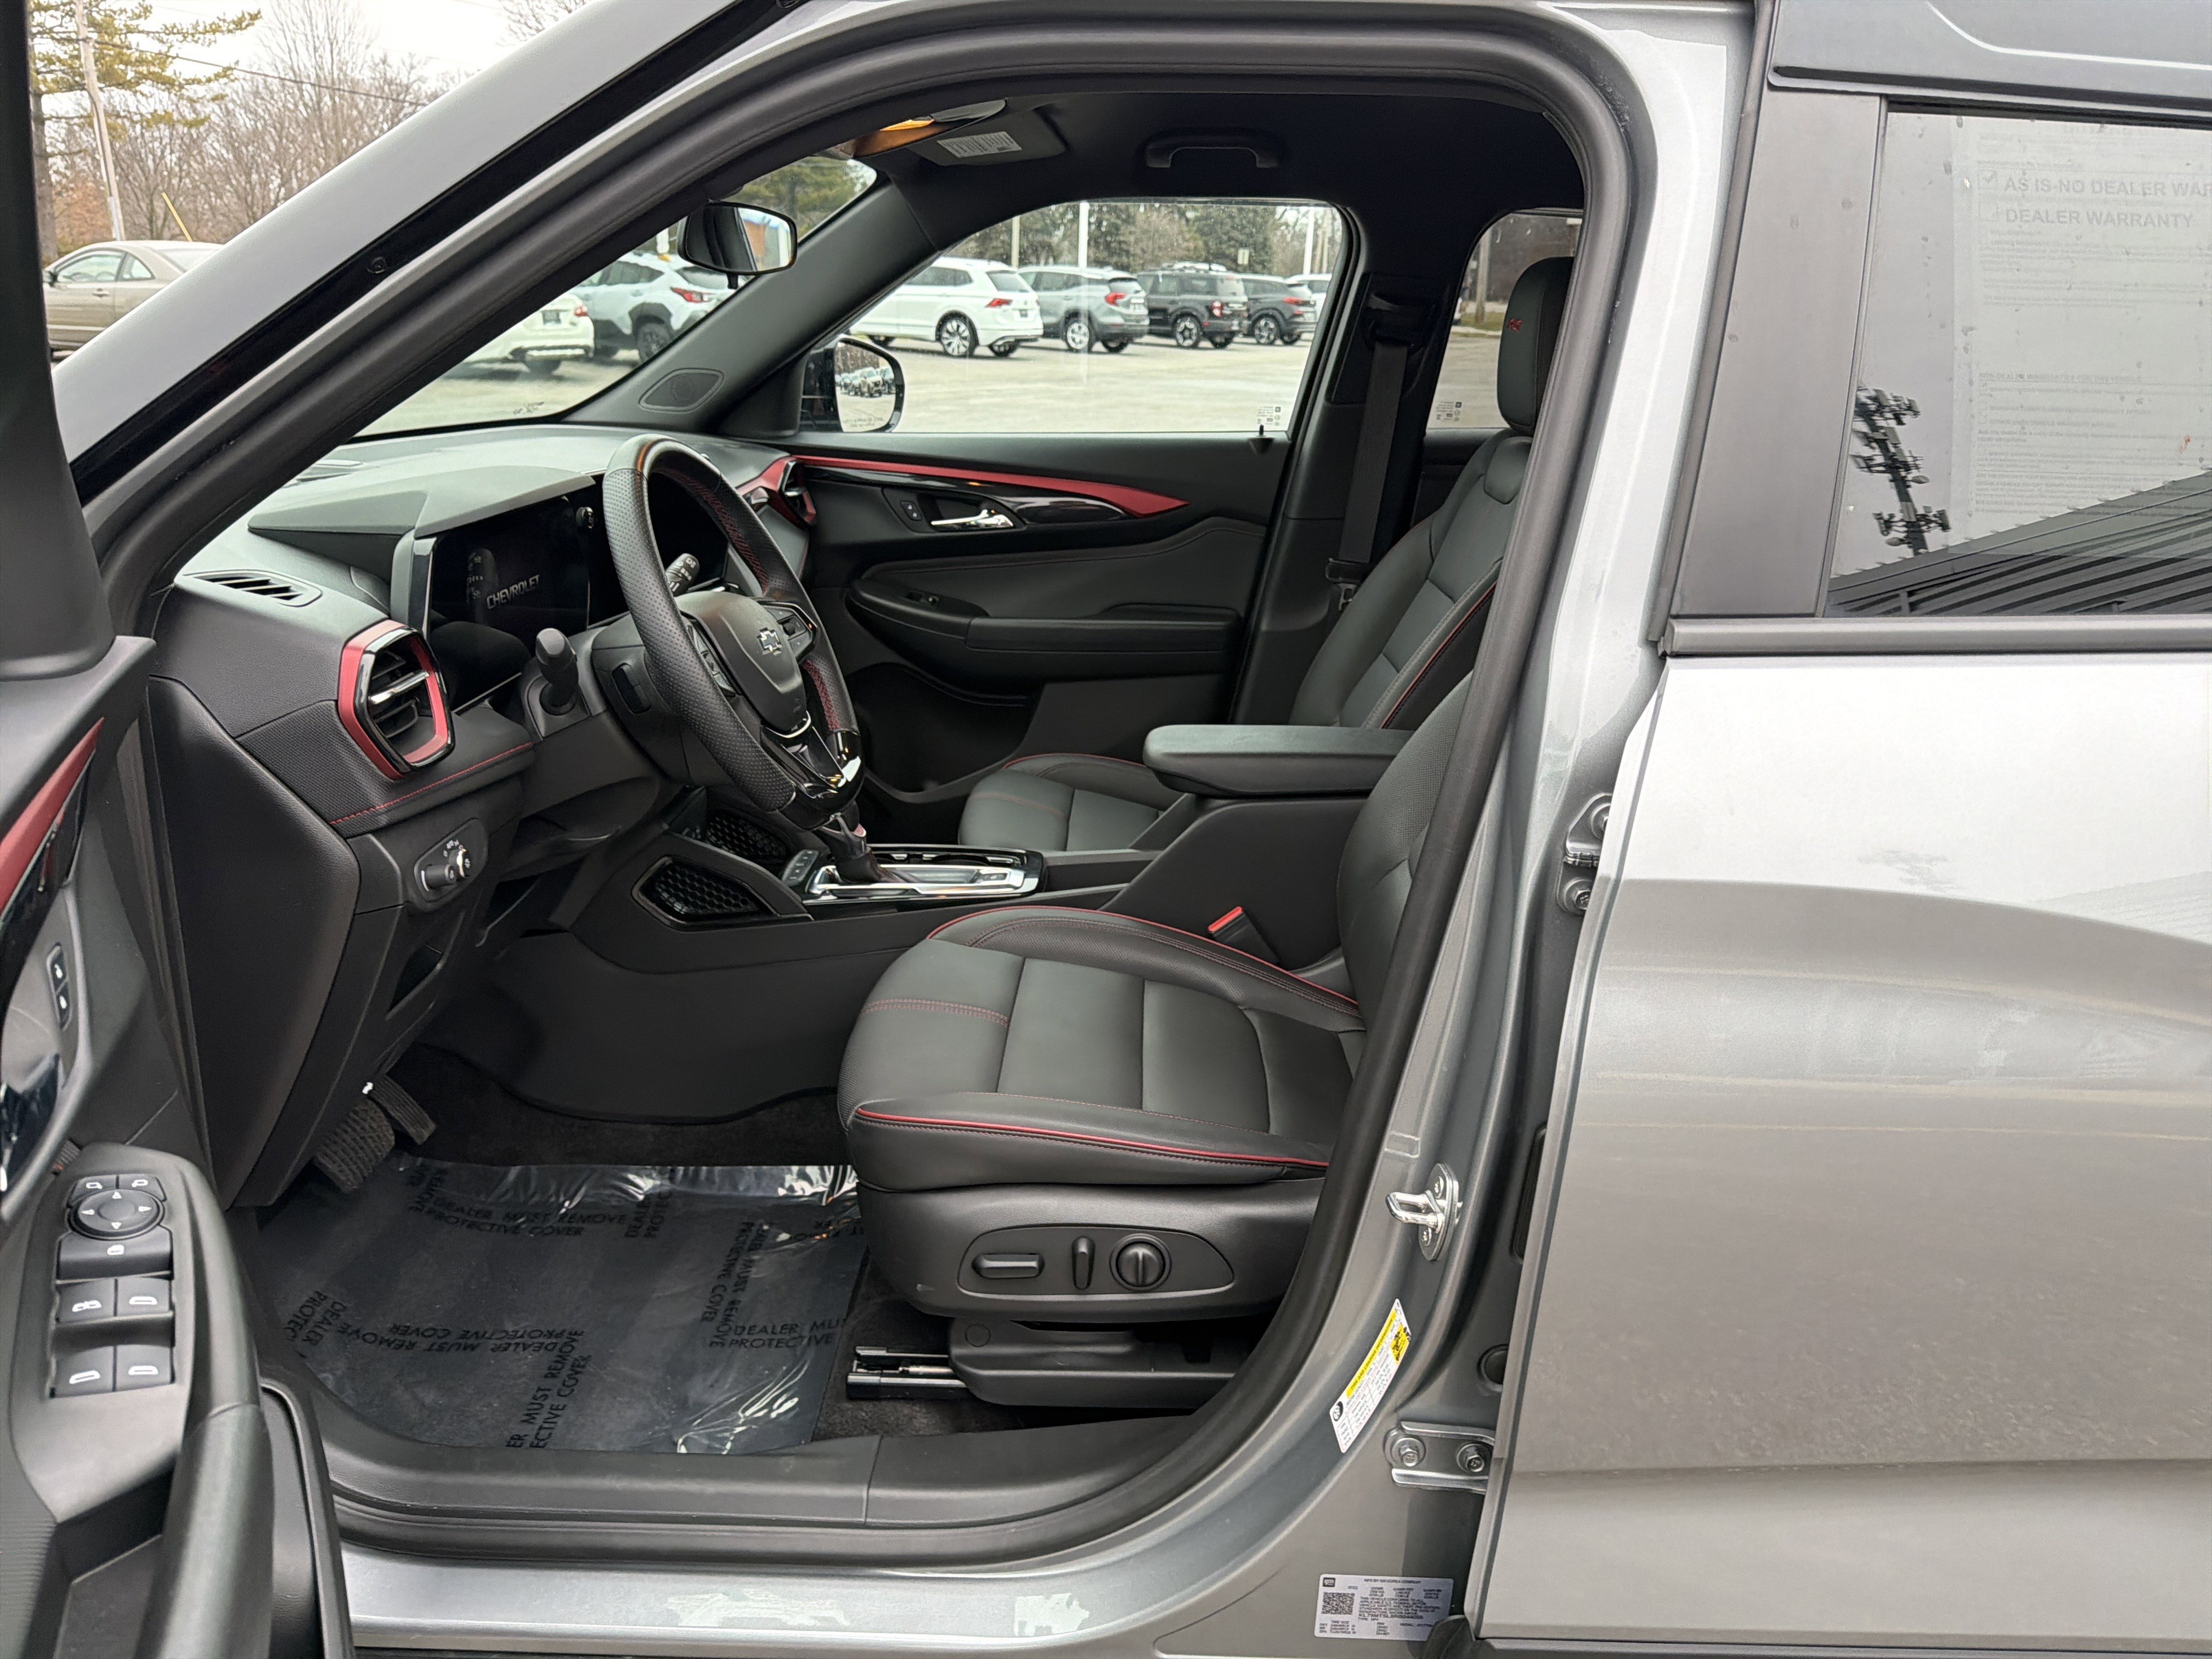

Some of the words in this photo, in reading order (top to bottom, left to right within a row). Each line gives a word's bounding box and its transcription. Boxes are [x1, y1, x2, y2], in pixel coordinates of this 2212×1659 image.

[2004, 176, 2029, 193] AS
[2091, 180, 2166, 196] DEALER
[2005, 208, 2081, 225] DEALER
[2085, 211, 2194, 228] WARRANTY
[486, 574, 540, 610] CHEVROLET
[528, 1224, 585, 1238] COVER
[701, 1284, 727, 1323] COVER
[301, 1301, 347, 1346] DEALER
[389, 1322, 453, 1338] COVER
[734, 1323, 799, 1335] DEALER
[337, 1322, 415, 1351] REMOVE
[461, 1327, 568, 1341] PROTECTIVE
[423, 1341, 478, 1353] MUST
[490, 1341, 559, 1353] DEALER
[521, 1386, 552, 1426] MUST
[543, 1329, 585, 1380] REMOVE
[556, 1352, 593, 1397] COVER
